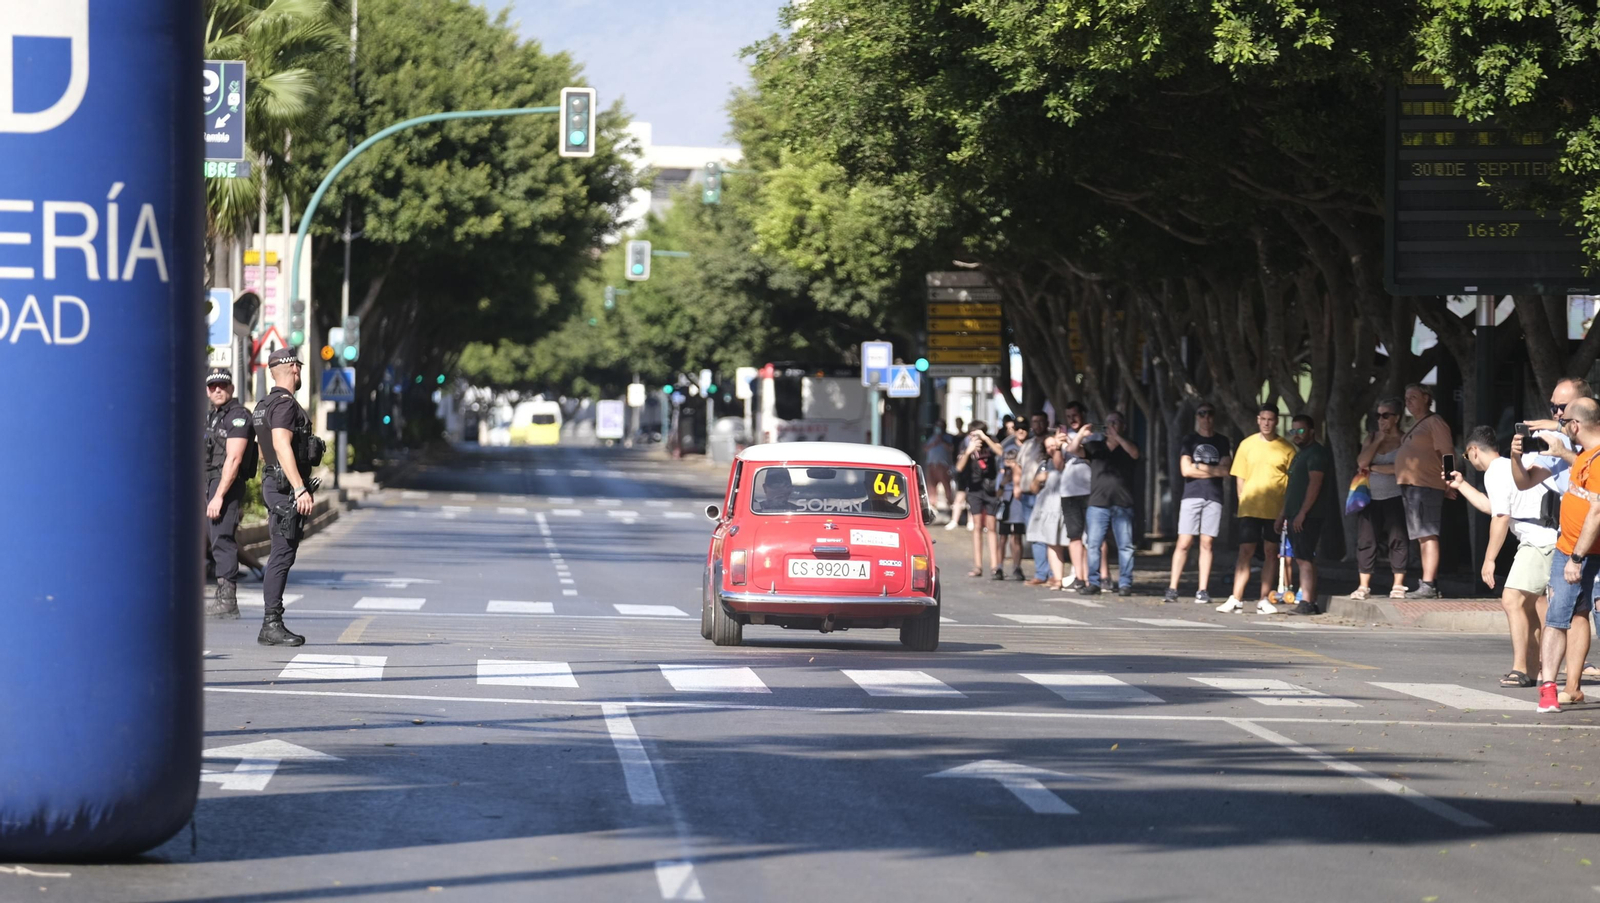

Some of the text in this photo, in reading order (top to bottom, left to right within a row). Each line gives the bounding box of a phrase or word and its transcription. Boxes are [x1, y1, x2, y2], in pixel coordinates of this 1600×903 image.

[1412, 163, 1432, 176] 30
[1445, 163, 1466, 176] DE
[0, 181, 169, 283] ERÍA
[1467, 223, 1520, 237] 16:37
[0, 294, 91, 345] AD
[873, 473, 901, 498] 64
